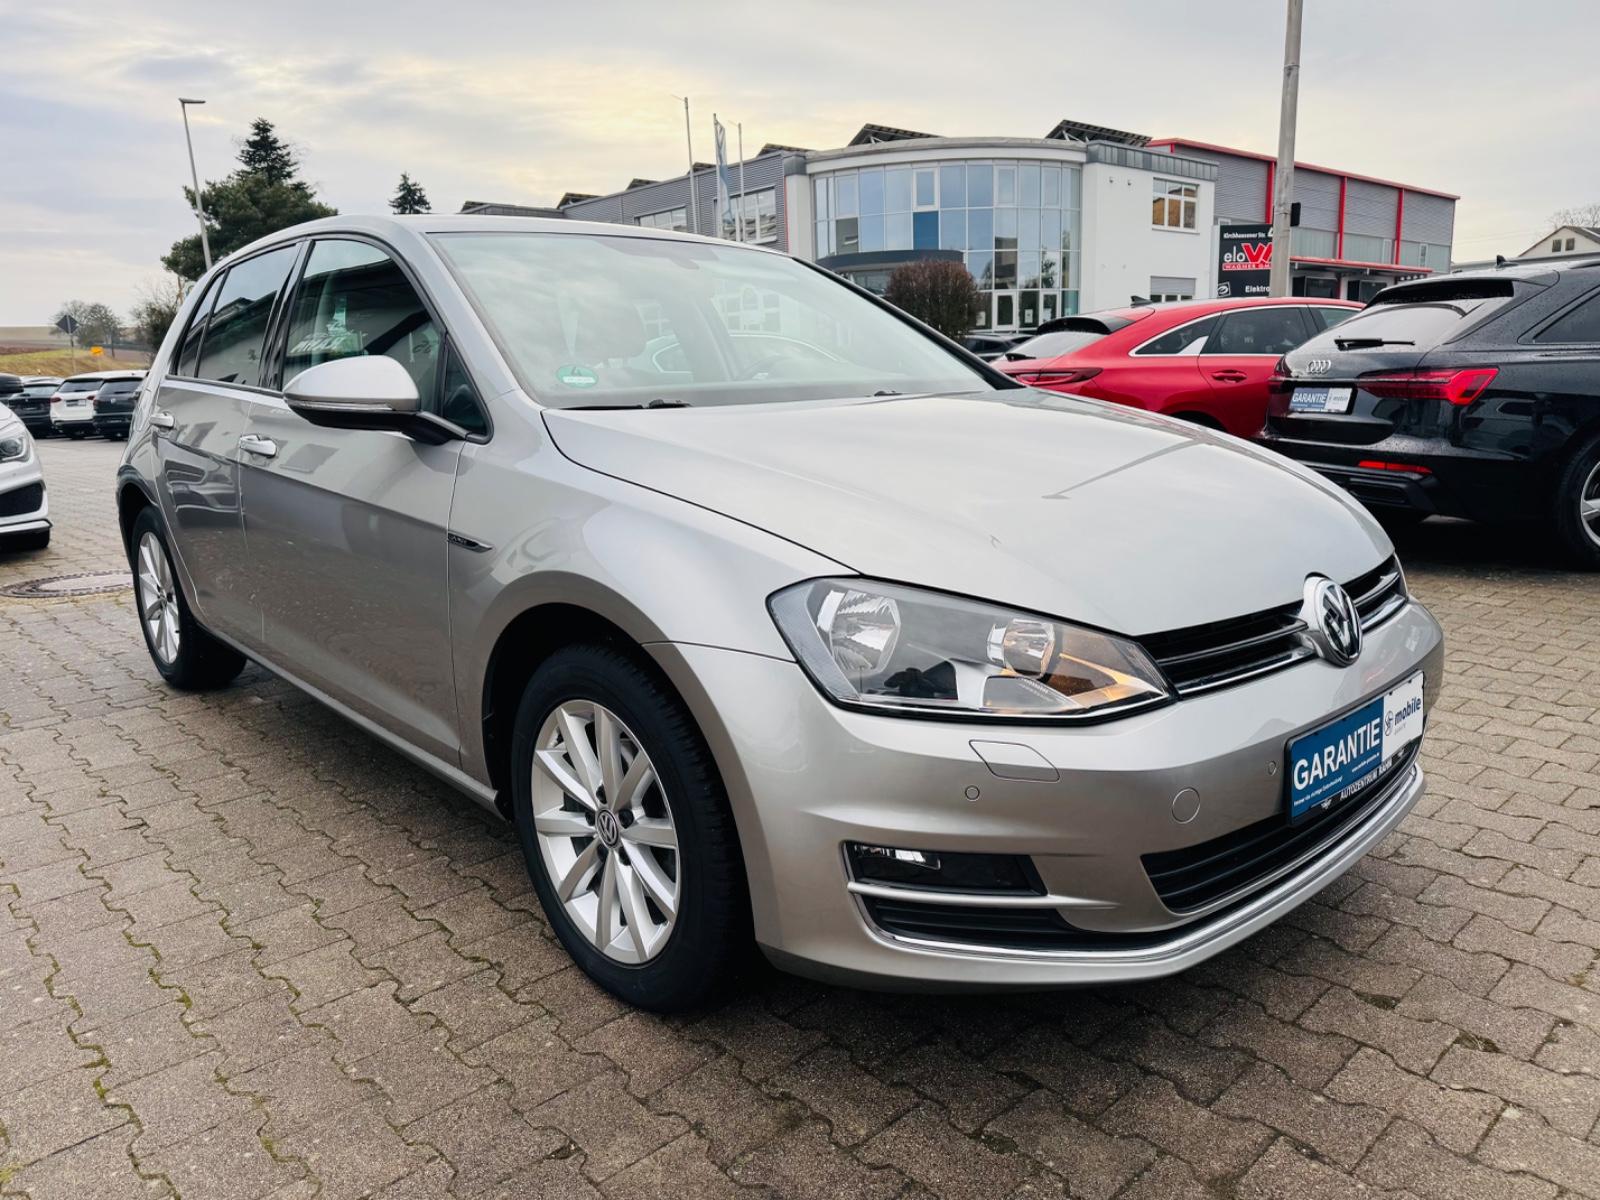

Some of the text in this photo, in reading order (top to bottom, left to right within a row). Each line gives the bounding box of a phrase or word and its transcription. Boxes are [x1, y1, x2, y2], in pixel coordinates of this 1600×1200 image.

[1245, 285, 1270, 293] Elektro
[1292, 392, 1327, 403] GARANTIE
[1394, 696, 1421, 726] mobile
[1293, 717, 1380, 791] GARANTIE
